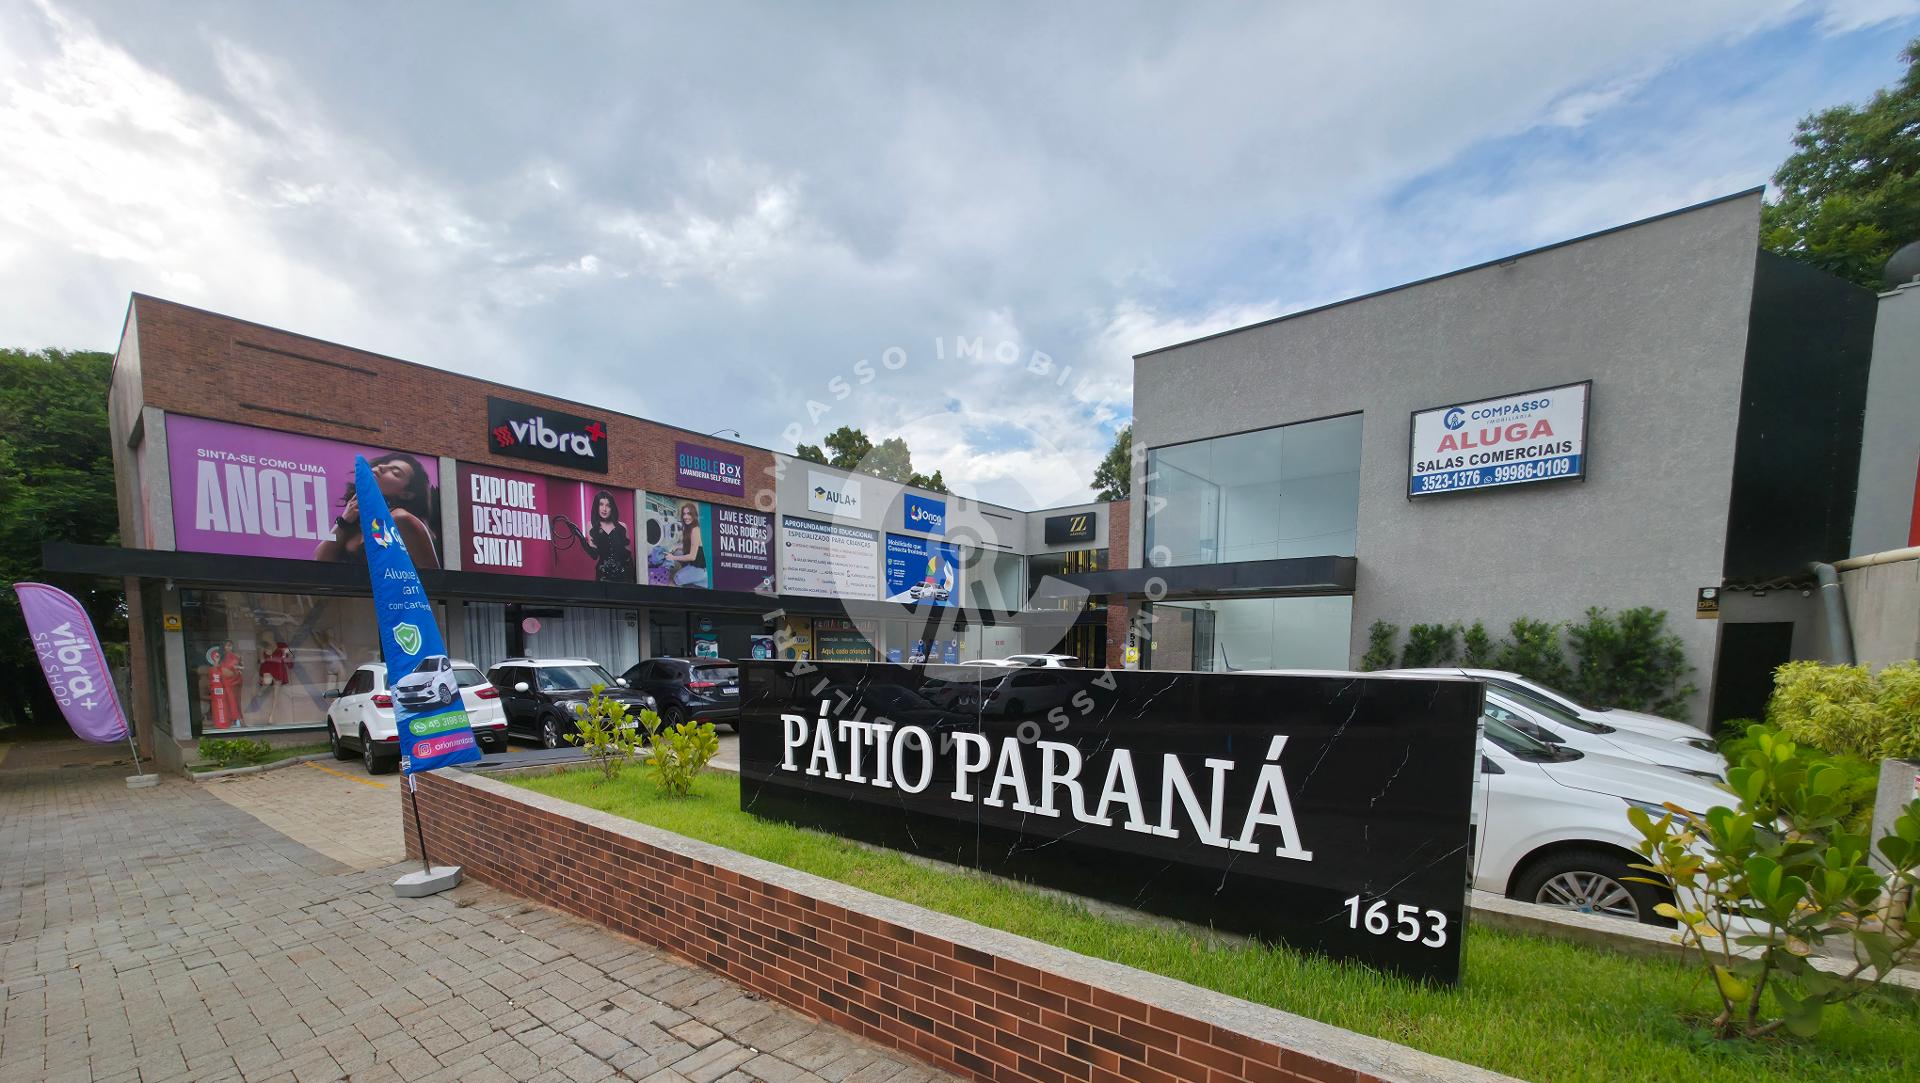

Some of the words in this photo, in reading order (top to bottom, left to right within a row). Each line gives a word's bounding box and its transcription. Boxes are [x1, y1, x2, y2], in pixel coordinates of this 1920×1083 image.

[1471, 398, 1550, 421] COMPASSO
[1436, 419, 1553, 453] ALUGA
[196, 448, 256, 464] SINTA-SE
[259, 457, 297, 472] COMO
[299, 463, 326, 475] UMA
[1416, 456, 1464, 473] SALAS
[1469, 441, 1572, 466] COMERCIAIS
[679, 468, 710, 480] LAVANDERIA
[710, 474, 721, 482] SELF
[722, 477, 741, 486] SERVICE
[1421, 470, 1481, 491] 3523-1376
[1494, 458, 1570, 483] 99986-0109
[195, 459, 338, 542] ANGEL
[471, 474, 536, 510] EXPLORE
[826, 490, 857, 506] AULA+
[472, 505, 552, 541] DESCUBRA
[720, 509, 738, 523] LAVE
[738, 512, 744, 524] E
[744, 513, 767, 527] SEQUE
[720, 522, 739, 536] SUAS
[740, 526, 767, 540] ROUPAS
[784, 519, 838, 534] APROFUNDAMENTO
[839, 528, 873, 540] EDUCACIONAL
[720, 535, 736, 552] NA
[738, 537, 767, 555] HORA
[789, 530, 830, 542] ESPECIALIZADO
[831, 536, 844, 544] PARA
[887, 539, 913, 549] Mobilidade
[473, 536, 523, 568] SINTA!
[33, 632, 56, 661] SEX
[45, 664, 72, 707] SHOP
[780, 698, 934, 794] PÁTIO
[951, 734, 1314, 862] PARANÁ
[1344, 893, 1449, 950] 1653
